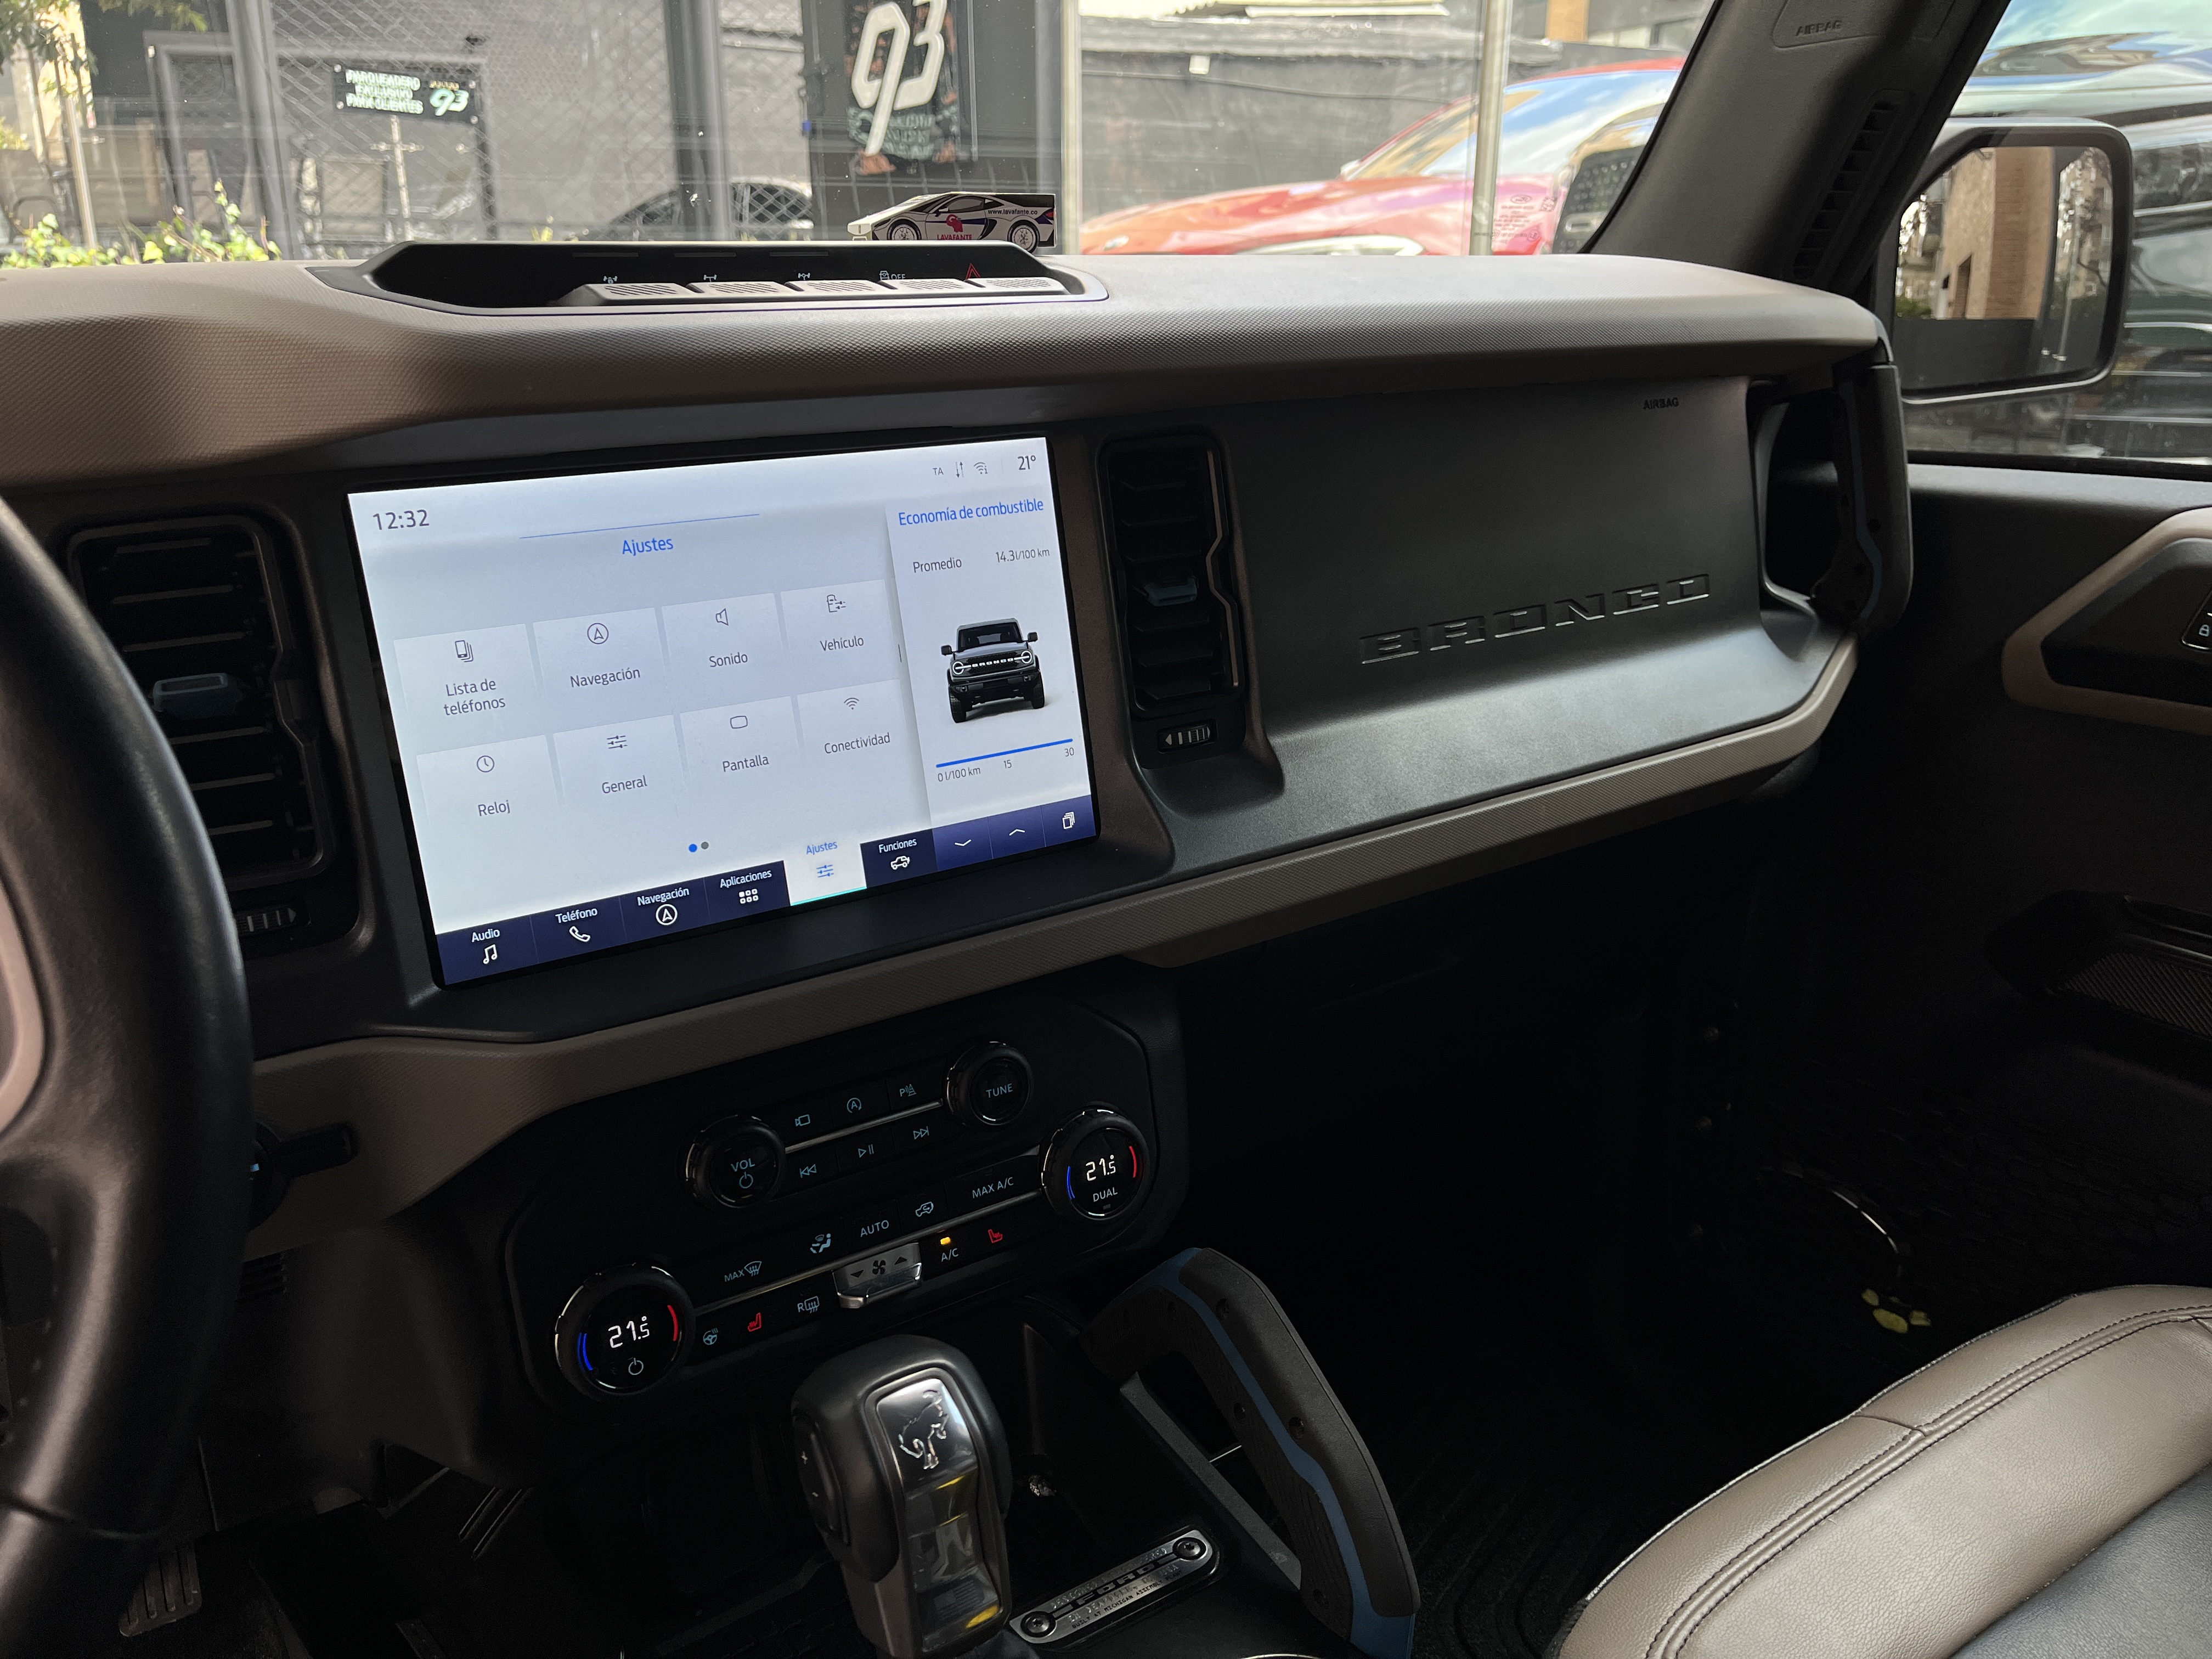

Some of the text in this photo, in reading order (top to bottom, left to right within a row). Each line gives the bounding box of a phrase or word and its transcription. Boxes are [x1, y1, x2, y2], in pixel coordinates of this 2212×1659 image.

[1796, 20, 1842, 36] AIRBAG
[430, 89, 469, 116] 93
[1643, 397, 1679, 410] AIRBAG
[933, 467, 944, 476] TA
[1018, 455, 1036, 471] 21°
[373, 509, 430, 531] 12:32
[898, 498, 1044, 526] Economía de combustible
[622, 537, 674, 556] Ajustes
[1037, 548, 1050, 558] km
[913, 557, 962, 573] Promedio
[1359, 573, 1709, 664] BRONCO
[820, 635, 865, 652] Vehículo
[709, 651, 748, 668] Sonido
[972, 658, 1014, 668] BRONCO
[569, 667, 641, 688] Navegación
[445, 679, 496, 697] Lista de
[443, 695, 506, 716] teléfonos
[823, 732, 891, 755] Conectividad
[1064, 747, 1075, 757] 30
[722, 754, 770, 772] Pantalla
[1003, 759, 1012, 769] 15
[938, 773, 943, 782] 0
[968, 766, 981, 776] km
[601, 775, 648, 794] General
[477, 799, 511, 817] Reloj
[806, 839, 838, 856] Ajustes
[878, 837, 917, 854] Funciones
[719, 868, 772, 889] Aplicaciones
[637, 886, 690, 906] Navegación
[555, 906, 598, 924] Teléfono
[471, 927, 500, 943] Audio
[986, 1083, 1013, 1098] TUNE
[731, 1158, 755, 1172] VOL
[972, 1176, 1014, 1199] MAX A/C
[1093, 1187, 1118, 1202] DUAL
[860, 1220, 890, 1237] AUTO
[941, 1248, 959, 1262] A/C
[724, 1269, 745, 1282] MAX
[797, 1302, 805, 1313] R
[1104, 1595, 1134, 1612] MICHIGAN
[1136, 1580, 1163, 1596] ASSEMBLY
